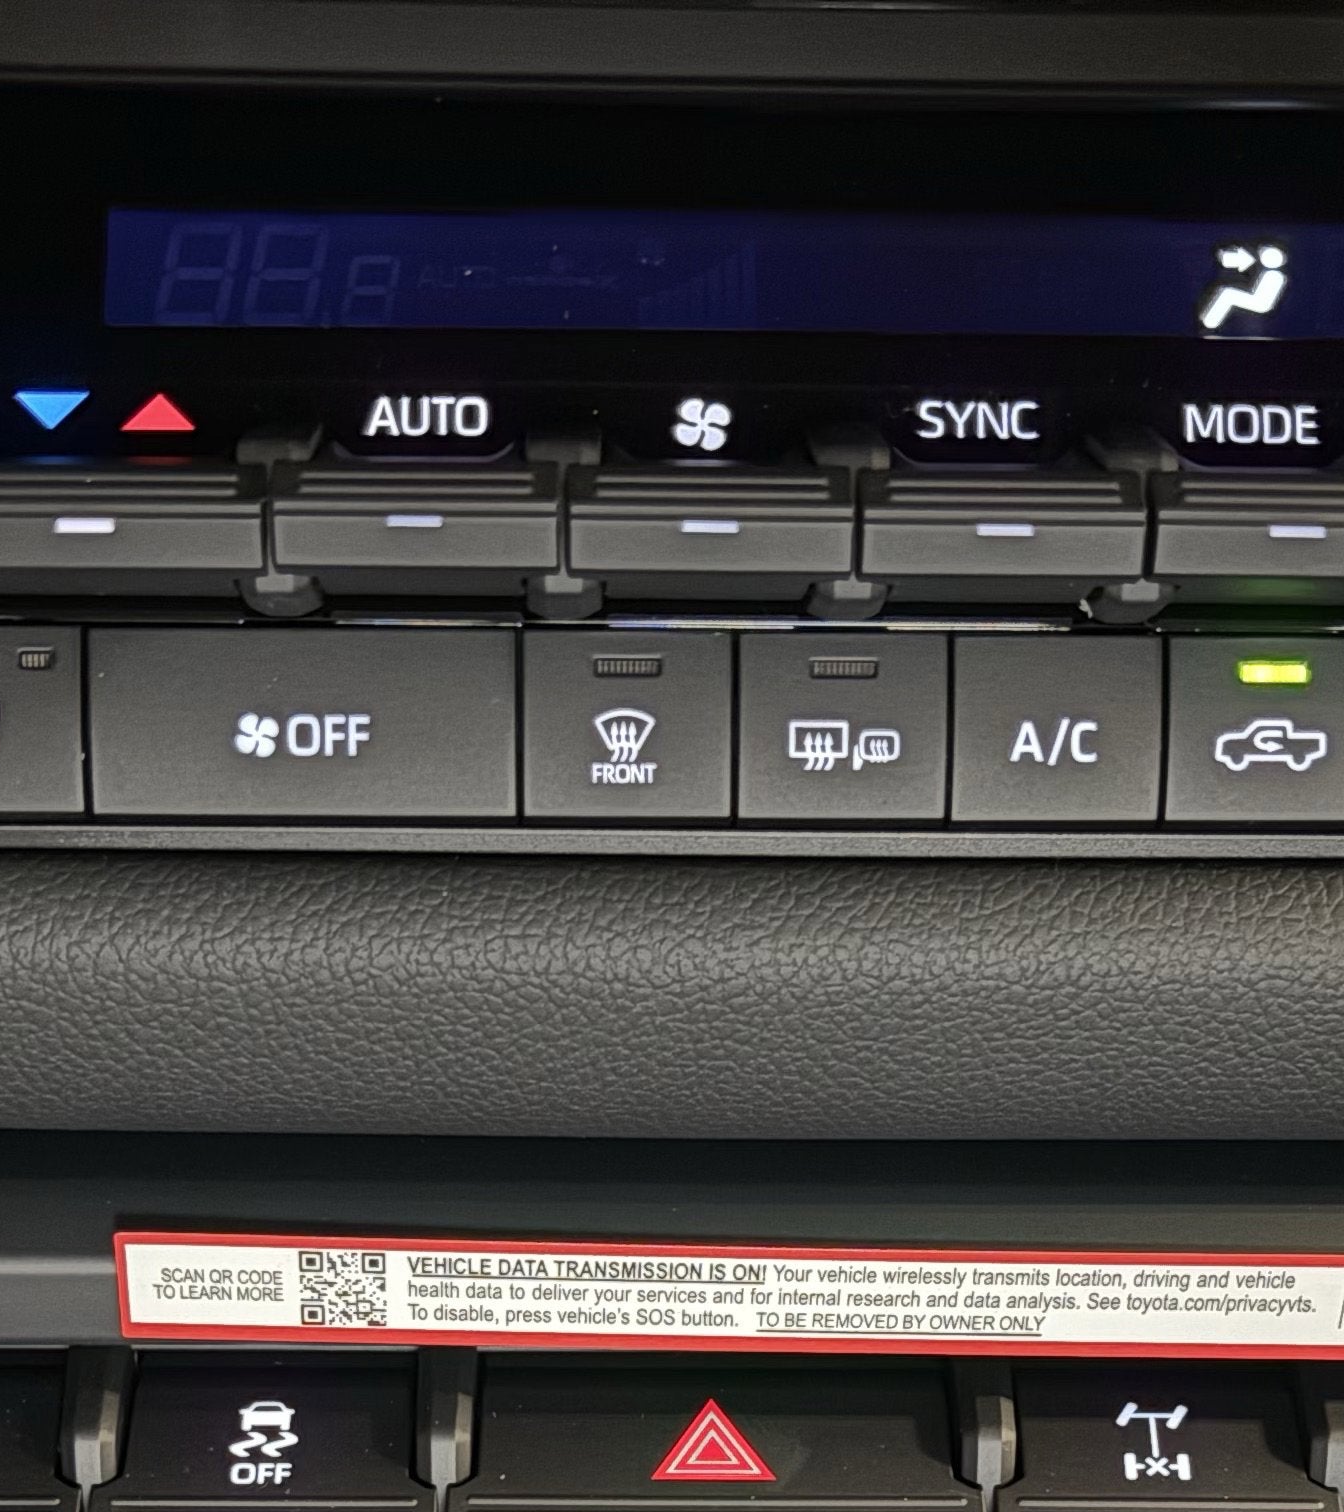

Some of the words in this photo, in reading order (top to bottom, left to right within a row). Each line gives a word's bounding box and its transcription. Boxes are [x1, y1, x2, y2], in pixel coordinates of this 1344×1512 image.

[363, 395, 489, 438] AUTO
[915, 400, 1040, 440] SYNC
[1183, 403, 1321, 445] MODE
[285, 713, 372, 758] OFF
[1010, 717, 1099, 766] A/C
[591, 762, 656, 785] FRONT
[154, 1284, 175, 1299] TO
[180, 1285, 232, 1300] LEARN
[237, 1287, 285, 1301] MORE
[160, 1268, 205, 1284] SCAN
[209, 1269, 234, 1285] QR
[237, 1269, 283, 1285] CODE
[407, 1257, 492, 1276] VEHICLE
[498, 1259, 549, 1277] DATA
[554, 1260, 703, 1280] TRANSMISSION
[709, 1263, 727, 1280] IS
[733, 1264, 767, 1282] ON!
[773, 1264, 813, 1283] Your
[817, 1266, 877, 1284] vehicle
[883, 1267, 967, 1289] wirelessly
[972, 1268, 1050, 1287] transmits
[1056, 1268, 1128, 1290] location,
[1133, 1269, 1191, 1292] driving
[1196, 1270, 1230, 1289] and
[1235, 1271, 1296, 1289] vehicle
[407, 1280, 460, 1299] health
[465, 1282, 503, 1300] data
[509, 1284, 525, 1300] to
[532, 1284, 588, 1301] deliver
[594, 1288, 632, 1306] your
[636, 1287, 707, 1304] services
[713, 1288, 744, 1304] and
[750, 1288, 773, 1305] for
[778, 1289, 841, 1306] internal
[846, 1290, 921, 1307] research
[926, 1291, 958, 1308] and
[964, 1291, 1001, 1309] data
[1006, 1292, 1081, 1313] analysis.
[1086, 1293, 1120, 1310] See
[1126, 1293, 1317, 1317] toyota.com/privacyvts.
[408, 1303, 428, 1321] To
[433, 1305, 499, 1325] disable,
[506, 1309, 552, 1327] press
[557, 1307, 630, 1325] vehicle's
[635, 1309, 675, 1326] SOS
[681, 1309, 739, 1327] button.
[756, 1312, 779, 1327] TO
[785, 1312, 807, 1328] BE
[812, 1313, 898, 1329] REMOVED
[903, 1314, 927, 1330] BY
[929, 1315, 995, 1330] OWNER
[1000, 1316, 1046, 1331] ONLY
[230, 1463, 292, 1485] OFF
